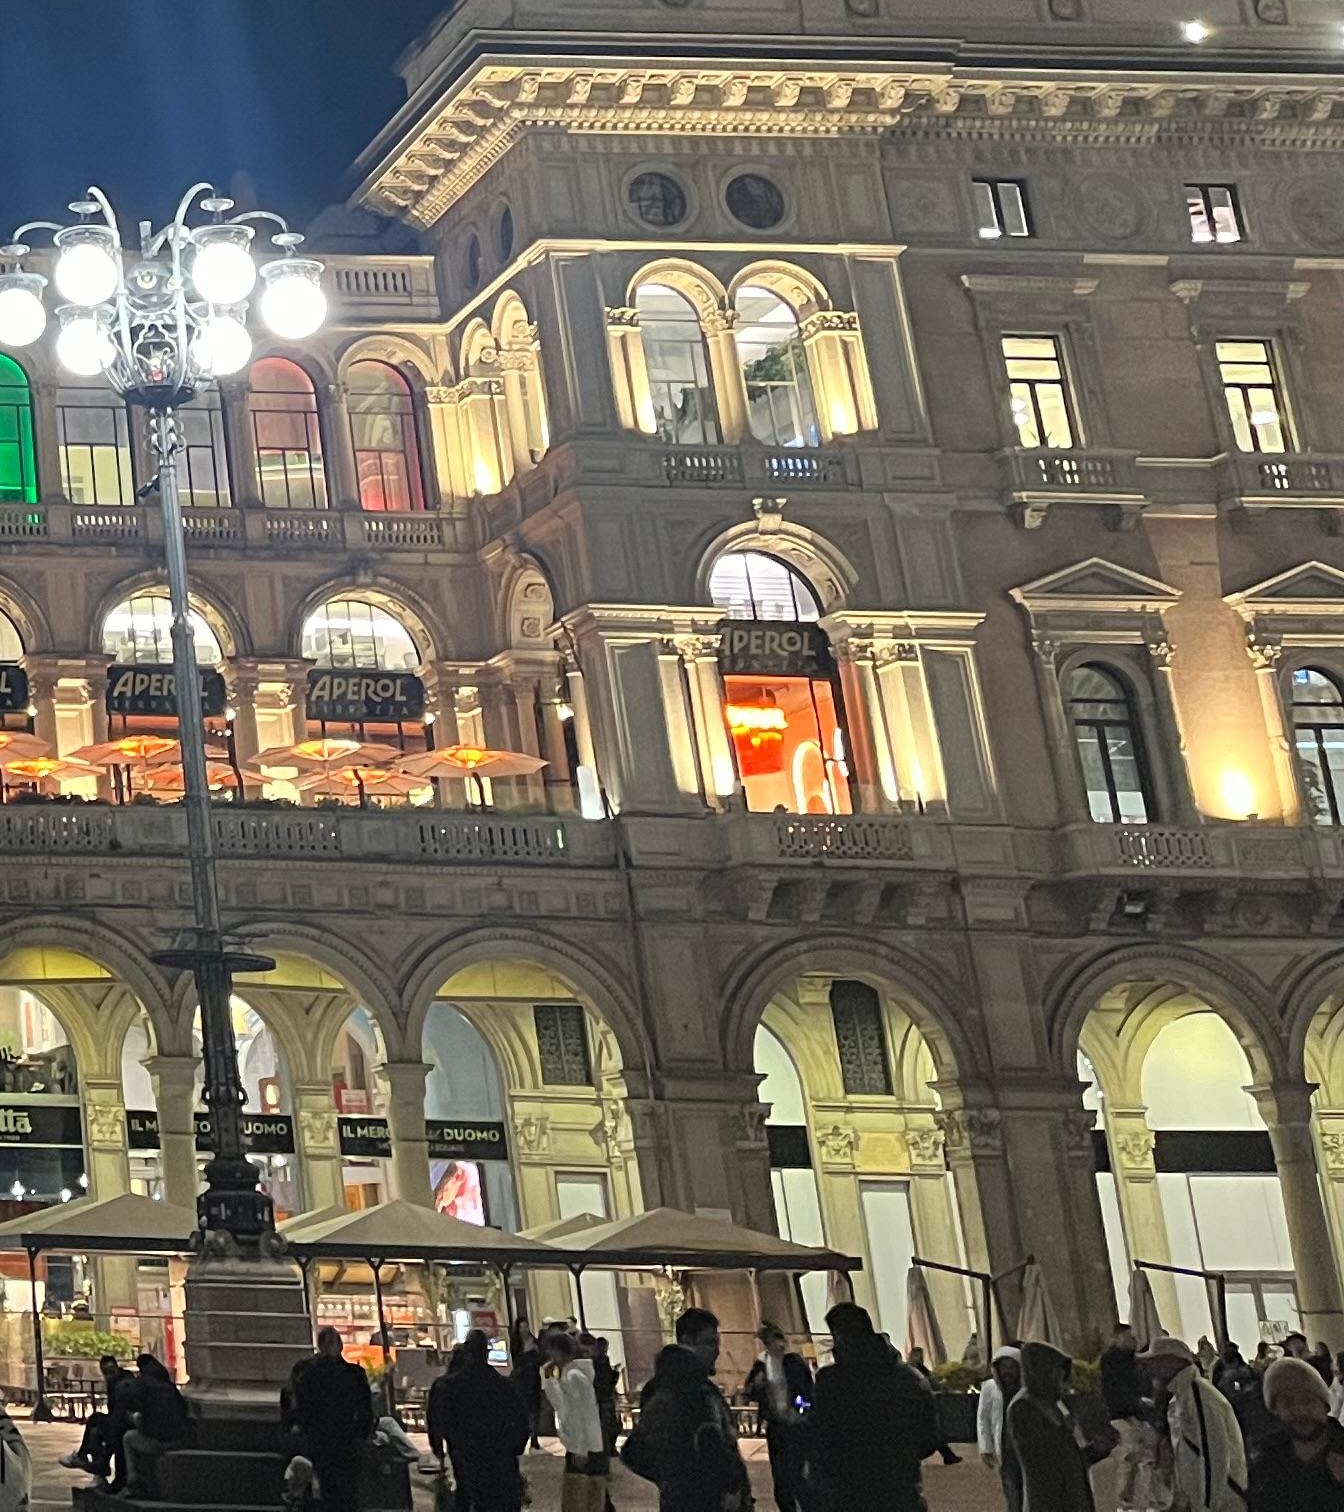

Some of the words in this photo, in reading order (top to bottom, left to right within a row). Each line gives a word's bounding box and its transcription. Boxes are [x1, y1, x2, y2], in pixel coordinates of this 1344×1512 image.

[113, 671, 209, 697] APERL
[311, 675, 407, 703] APEROL
[242, 1121, 288, 1135] UOMO
[342, 1124, 355, 1138] IL
[443, 1128, 500, 1142] DUOMO
